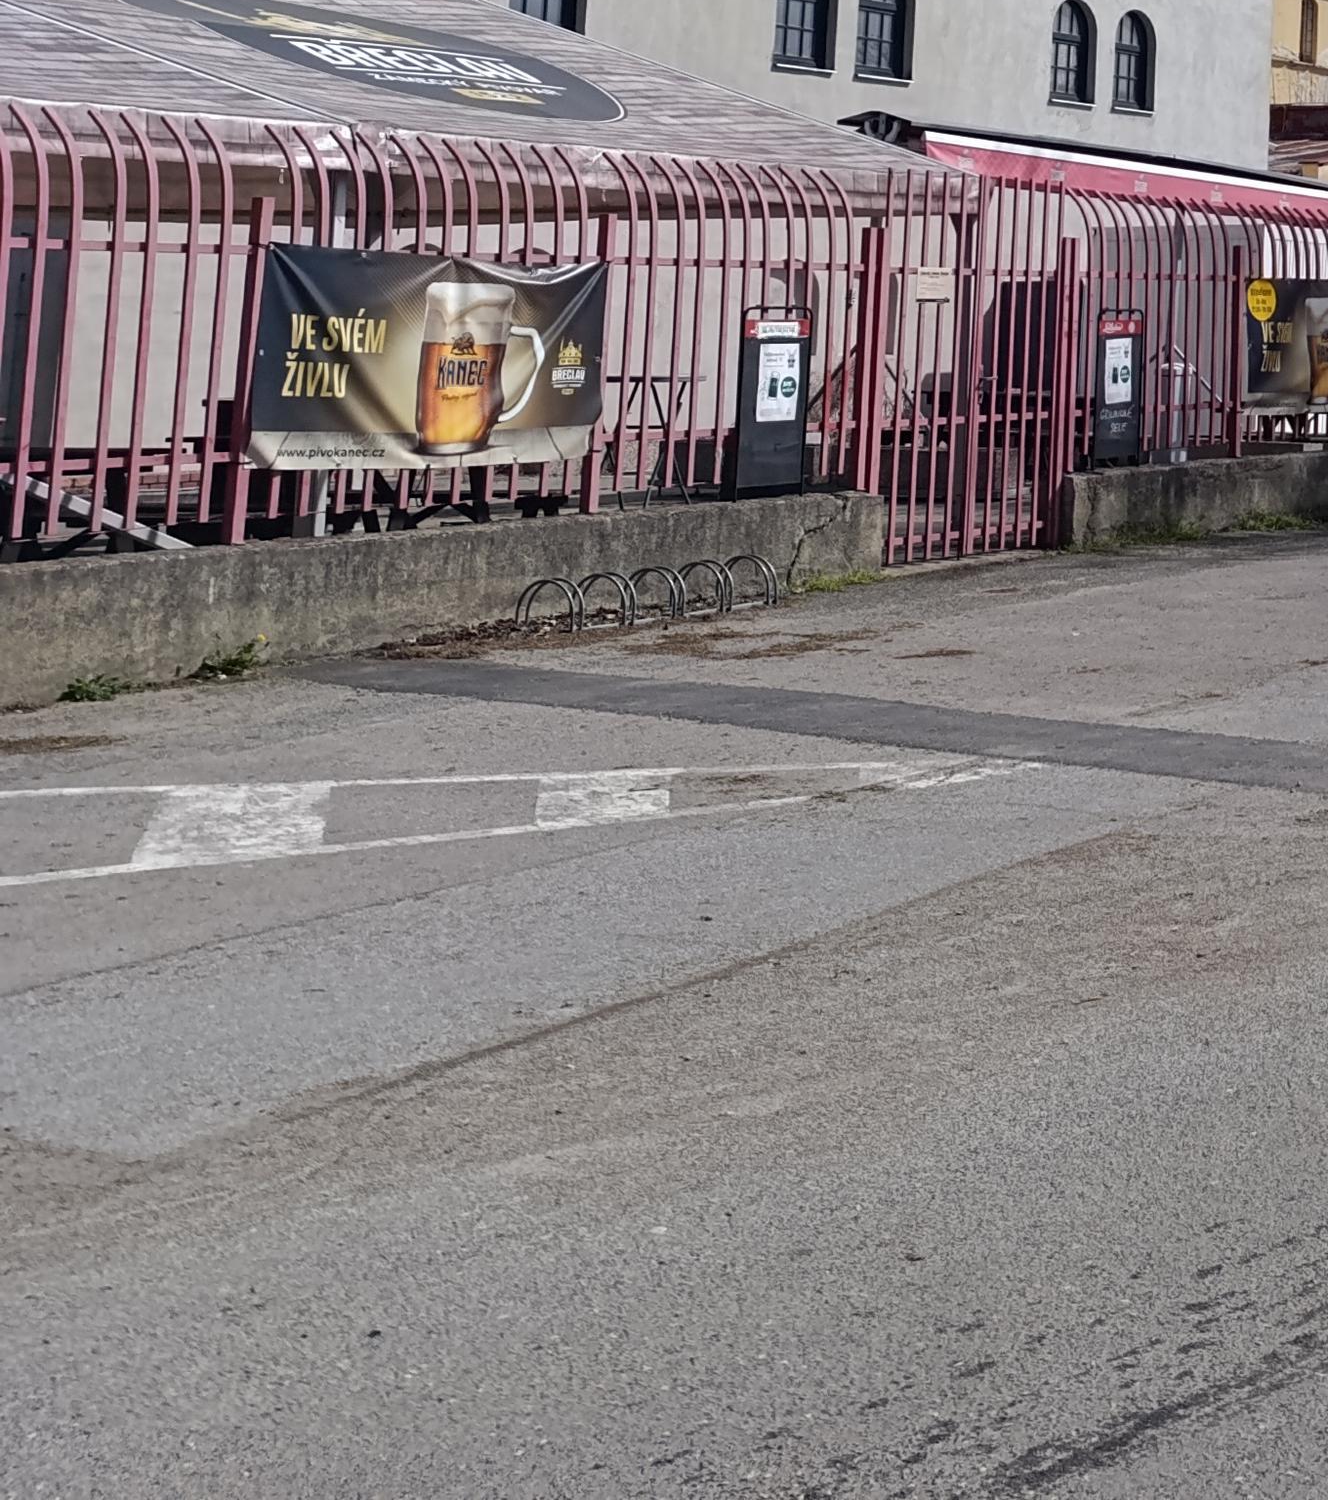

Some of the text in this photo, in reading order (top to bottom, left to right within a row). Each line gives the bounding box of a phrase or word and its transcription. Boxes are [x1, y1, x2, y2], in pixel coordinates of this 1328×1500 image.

[290, 307, 388, 355] VE SVÉM
[1260, 321, 1274, 344] VE
[281, 351, 351, 399] ŽIVLU
[437, 355, 488, 391] KANEC
[277, 445, 386, 460] www.pivokanec.cz
